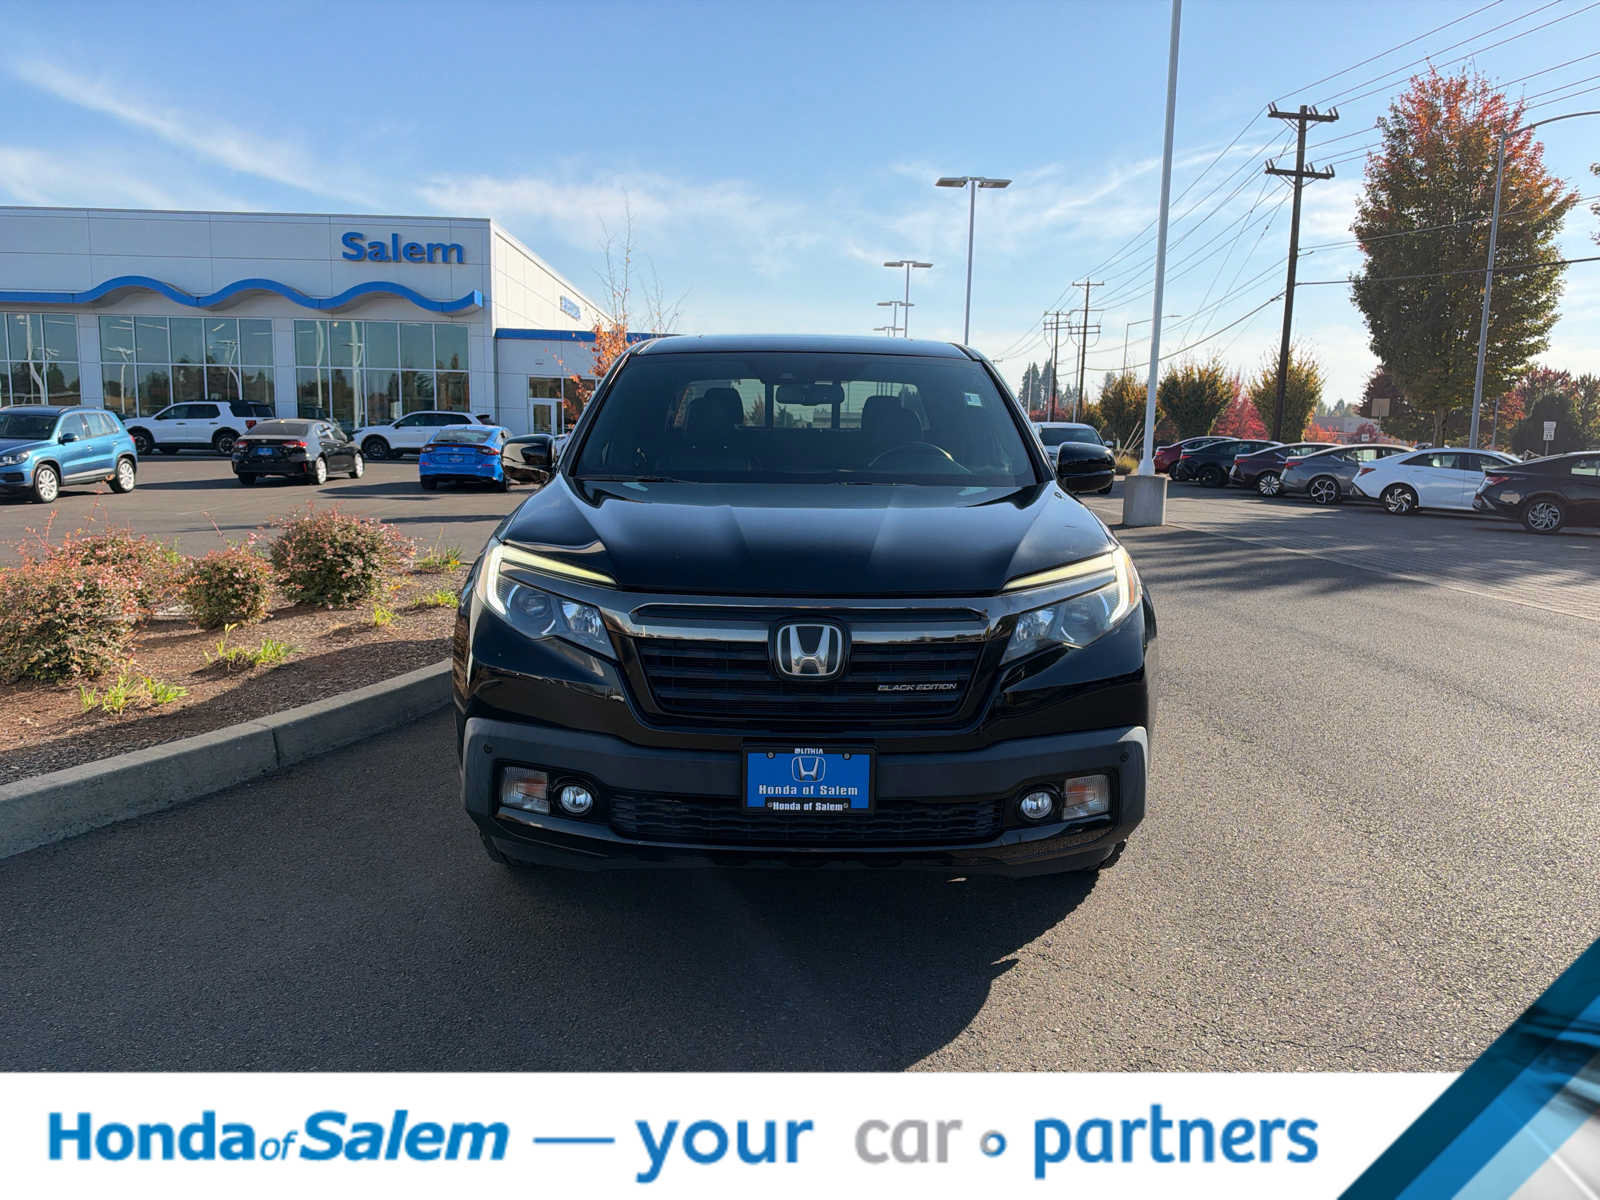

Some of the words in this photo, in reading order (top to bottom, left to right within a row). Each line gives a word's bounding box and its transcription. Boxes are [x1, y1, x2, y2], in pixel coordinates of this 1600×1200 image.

[341, 231, 465, 264] Salem
[877, 684, 915, 692] BLACK
[915, 682, 958, 691] EDITION
[800, 747, 824, 755] LITHIA
[758, 784, 798, 795] Honda
[802, 785, 815, 795] of
[819, 785, 858, 796] Salem
[772, 801, 801, 811] Honda
[803, 802, 813, 811] of
[815, 802, 843, 812] Salem
